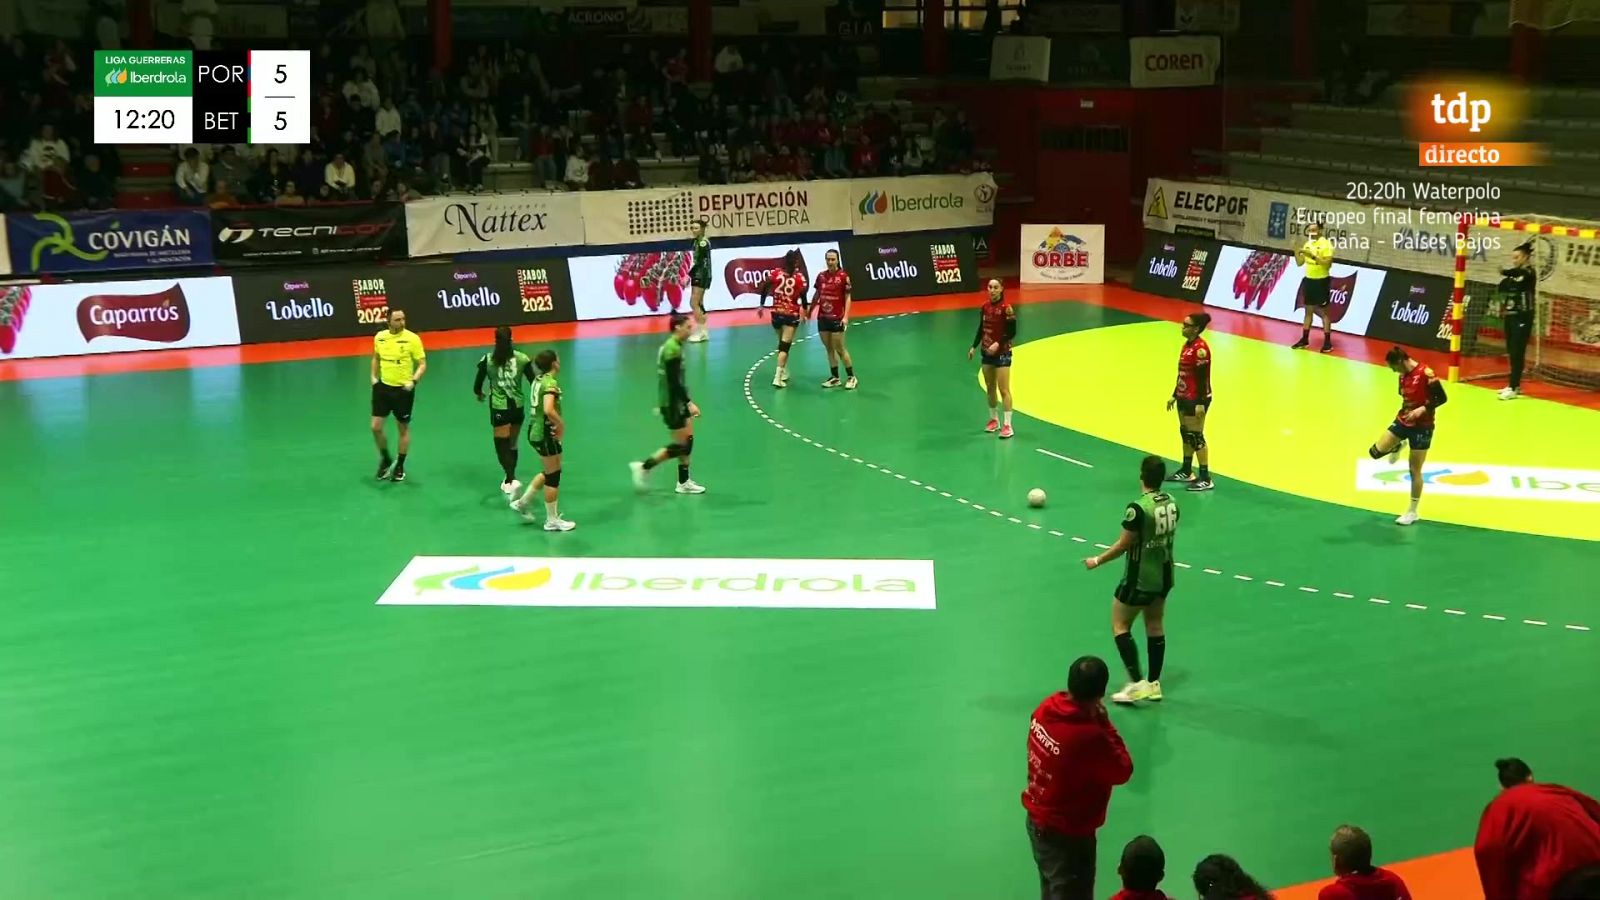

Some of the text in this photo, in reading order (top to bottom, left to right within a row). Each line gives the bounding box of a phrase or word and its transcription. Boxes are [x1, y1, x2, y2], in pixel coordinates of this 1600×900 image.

[699, 186, 808, 212] DEPUTACIÓN
[891, 192, 964, 213] Iberdrola
[444, 203, 548, 242] Nattex
[1032, 250, 1089, 268] ORBE
[522, 269, 548, 281] SABOR
[865, 260, 918, 280] Lobello
[935, 268, 962, 284] 2023
[357, 278, 385, 291] SABOR
[774, 275, 796, 296] 28
[437, 286, 501, 309] Lobello
[521, 294, 553, 312] 2023
[265, 297, 334, 321] Lobello
[1390, 300, 1430, 325] Lobello
[1154, 502, 1178, 536] 66
[572, 573, 917, 593] Iberdrola
